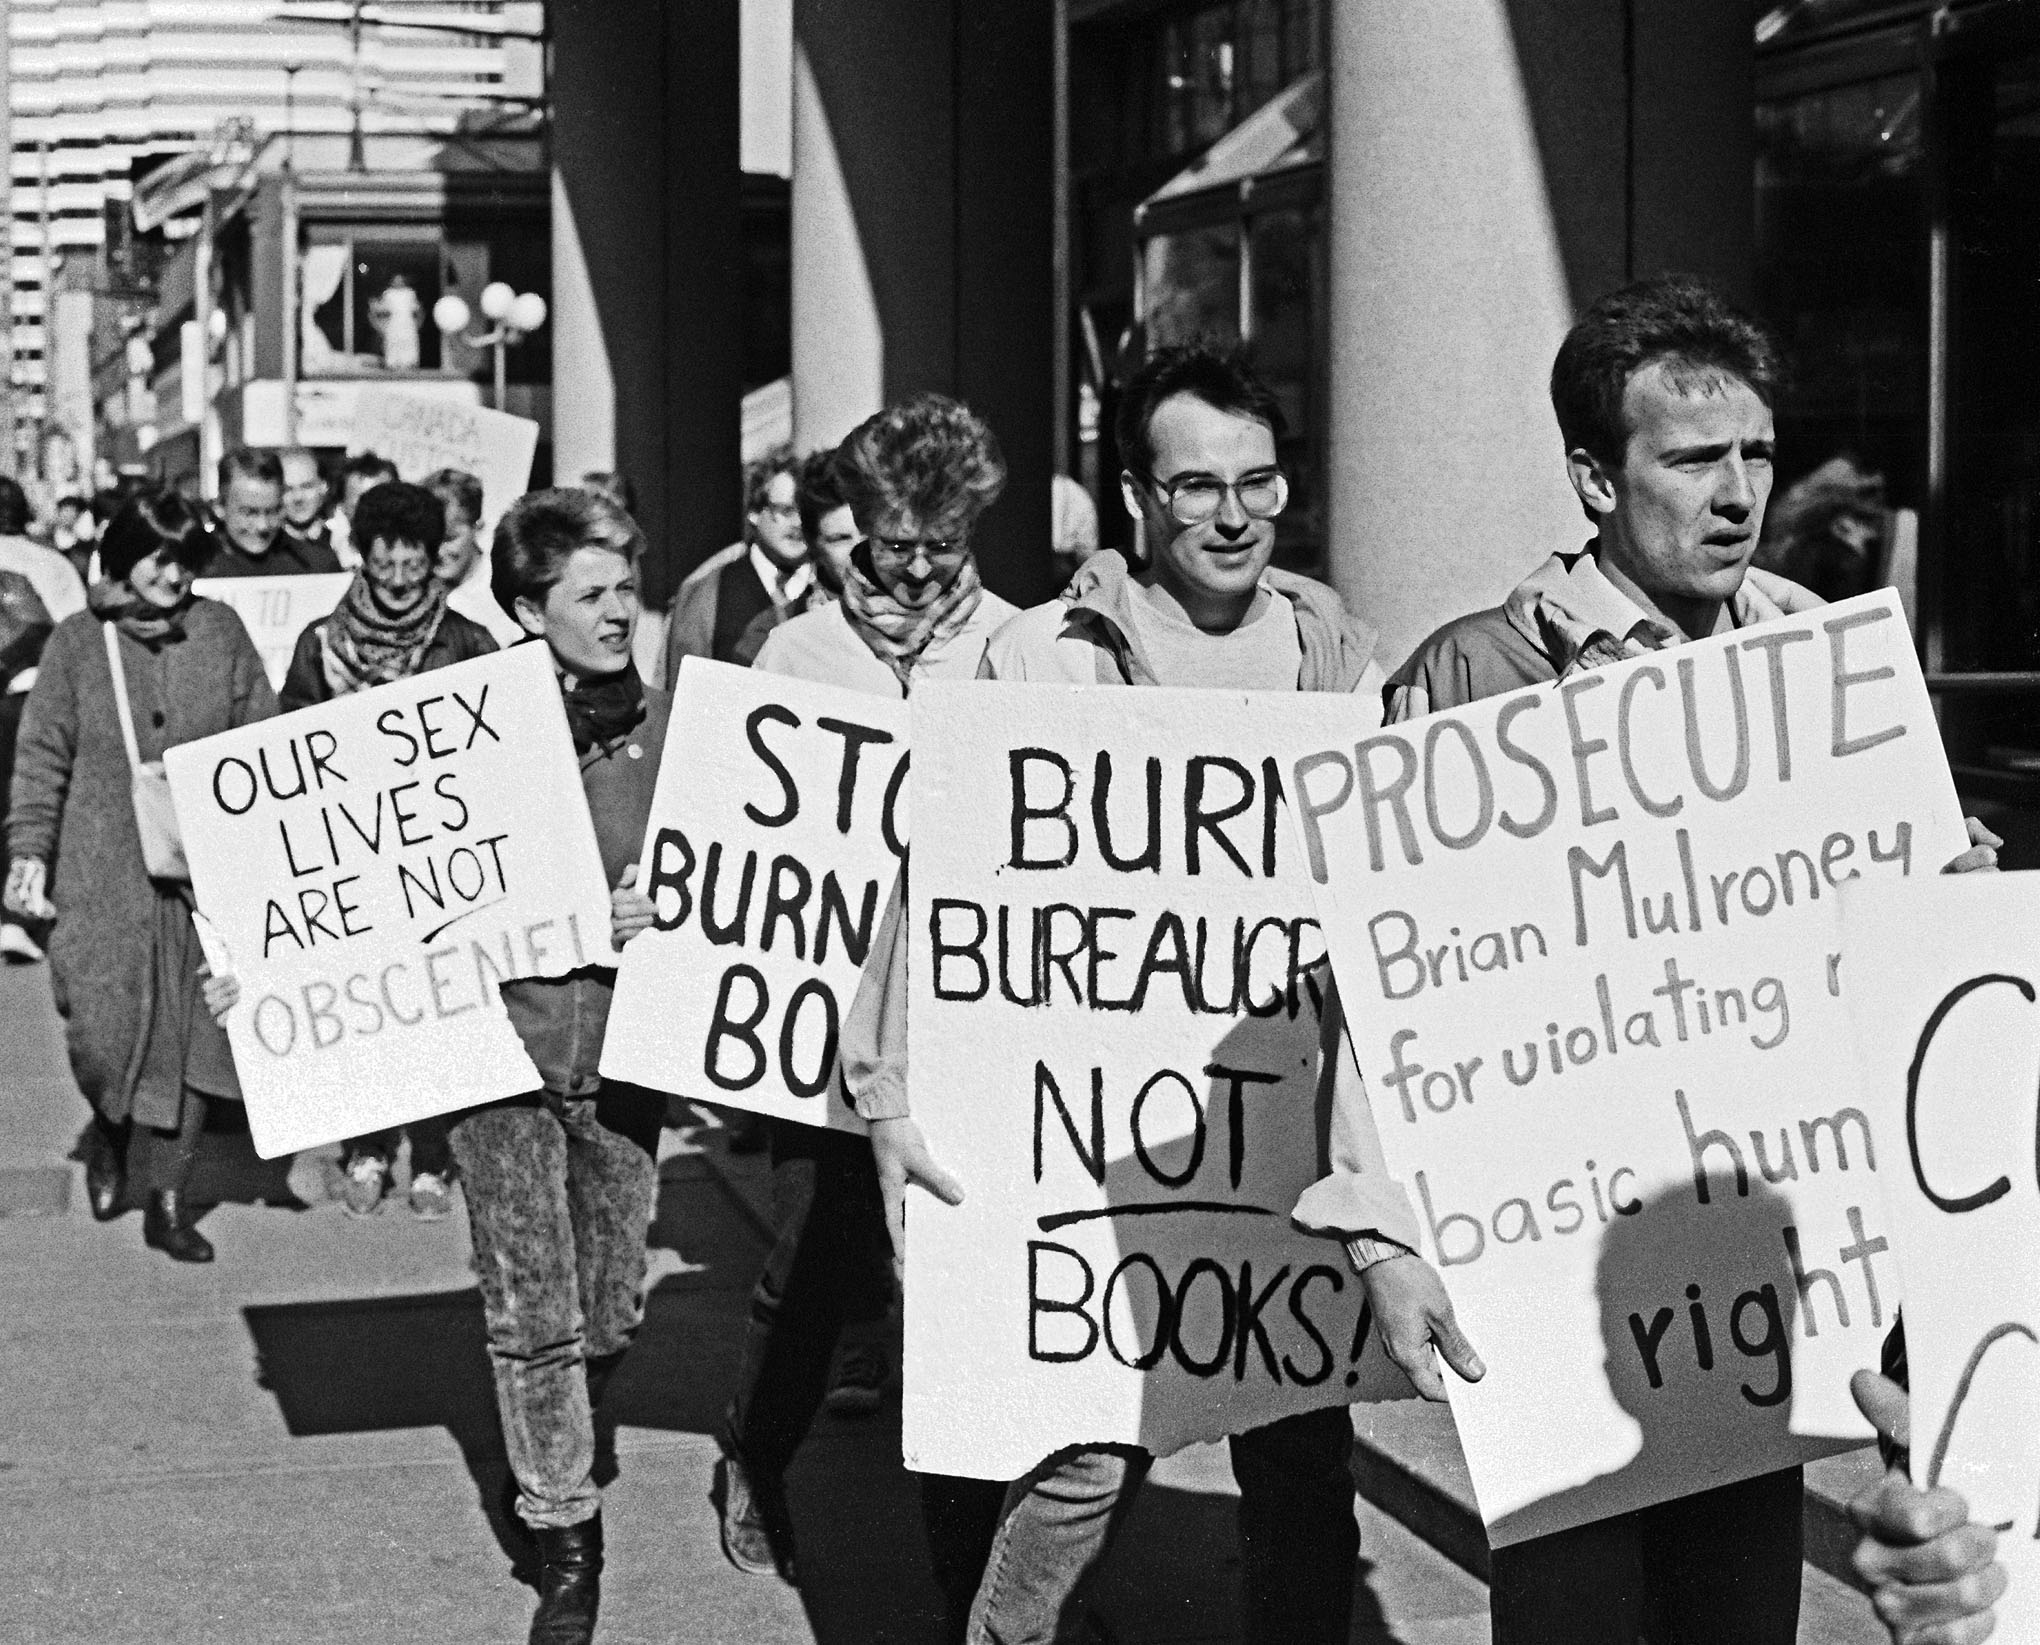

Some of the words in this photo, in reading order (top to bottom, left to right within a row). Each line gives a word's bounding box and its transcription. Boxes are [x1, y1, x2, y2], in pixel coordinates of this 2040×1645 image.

[212, 729, 348, 815] OUR
[376, 684, 500, 767] SEX
[1292, 605, 1907, 885] PROSECUTE
[264, 875, 373, 958] ARE
[398, 834, 508, 919] NOT
[279, 773, 469, 877] LIVES
[648, 827, 879, 968] BURN
[928, 897, 1332, 1021] BUREAUCR
[1366, 909, 1548, 1001] Brian
[1567, 821, 1912, 947] Mulroney
[704, 962, 840, 1098] BO
[1381, 1028, 1484, 1123] for
[1501, 973, 1790, 1087] violating
[1905, 973, 2040, 1214] C
[1033, 1058, 1283, 1190] NOT
[1414, 1158, 1643, 1267] basic
[1674, 1088, 1878, 1205] hum
[1026, 1238, 1370, 1388] BOOKS!
[1627, 1205, 1894, 1407] right
